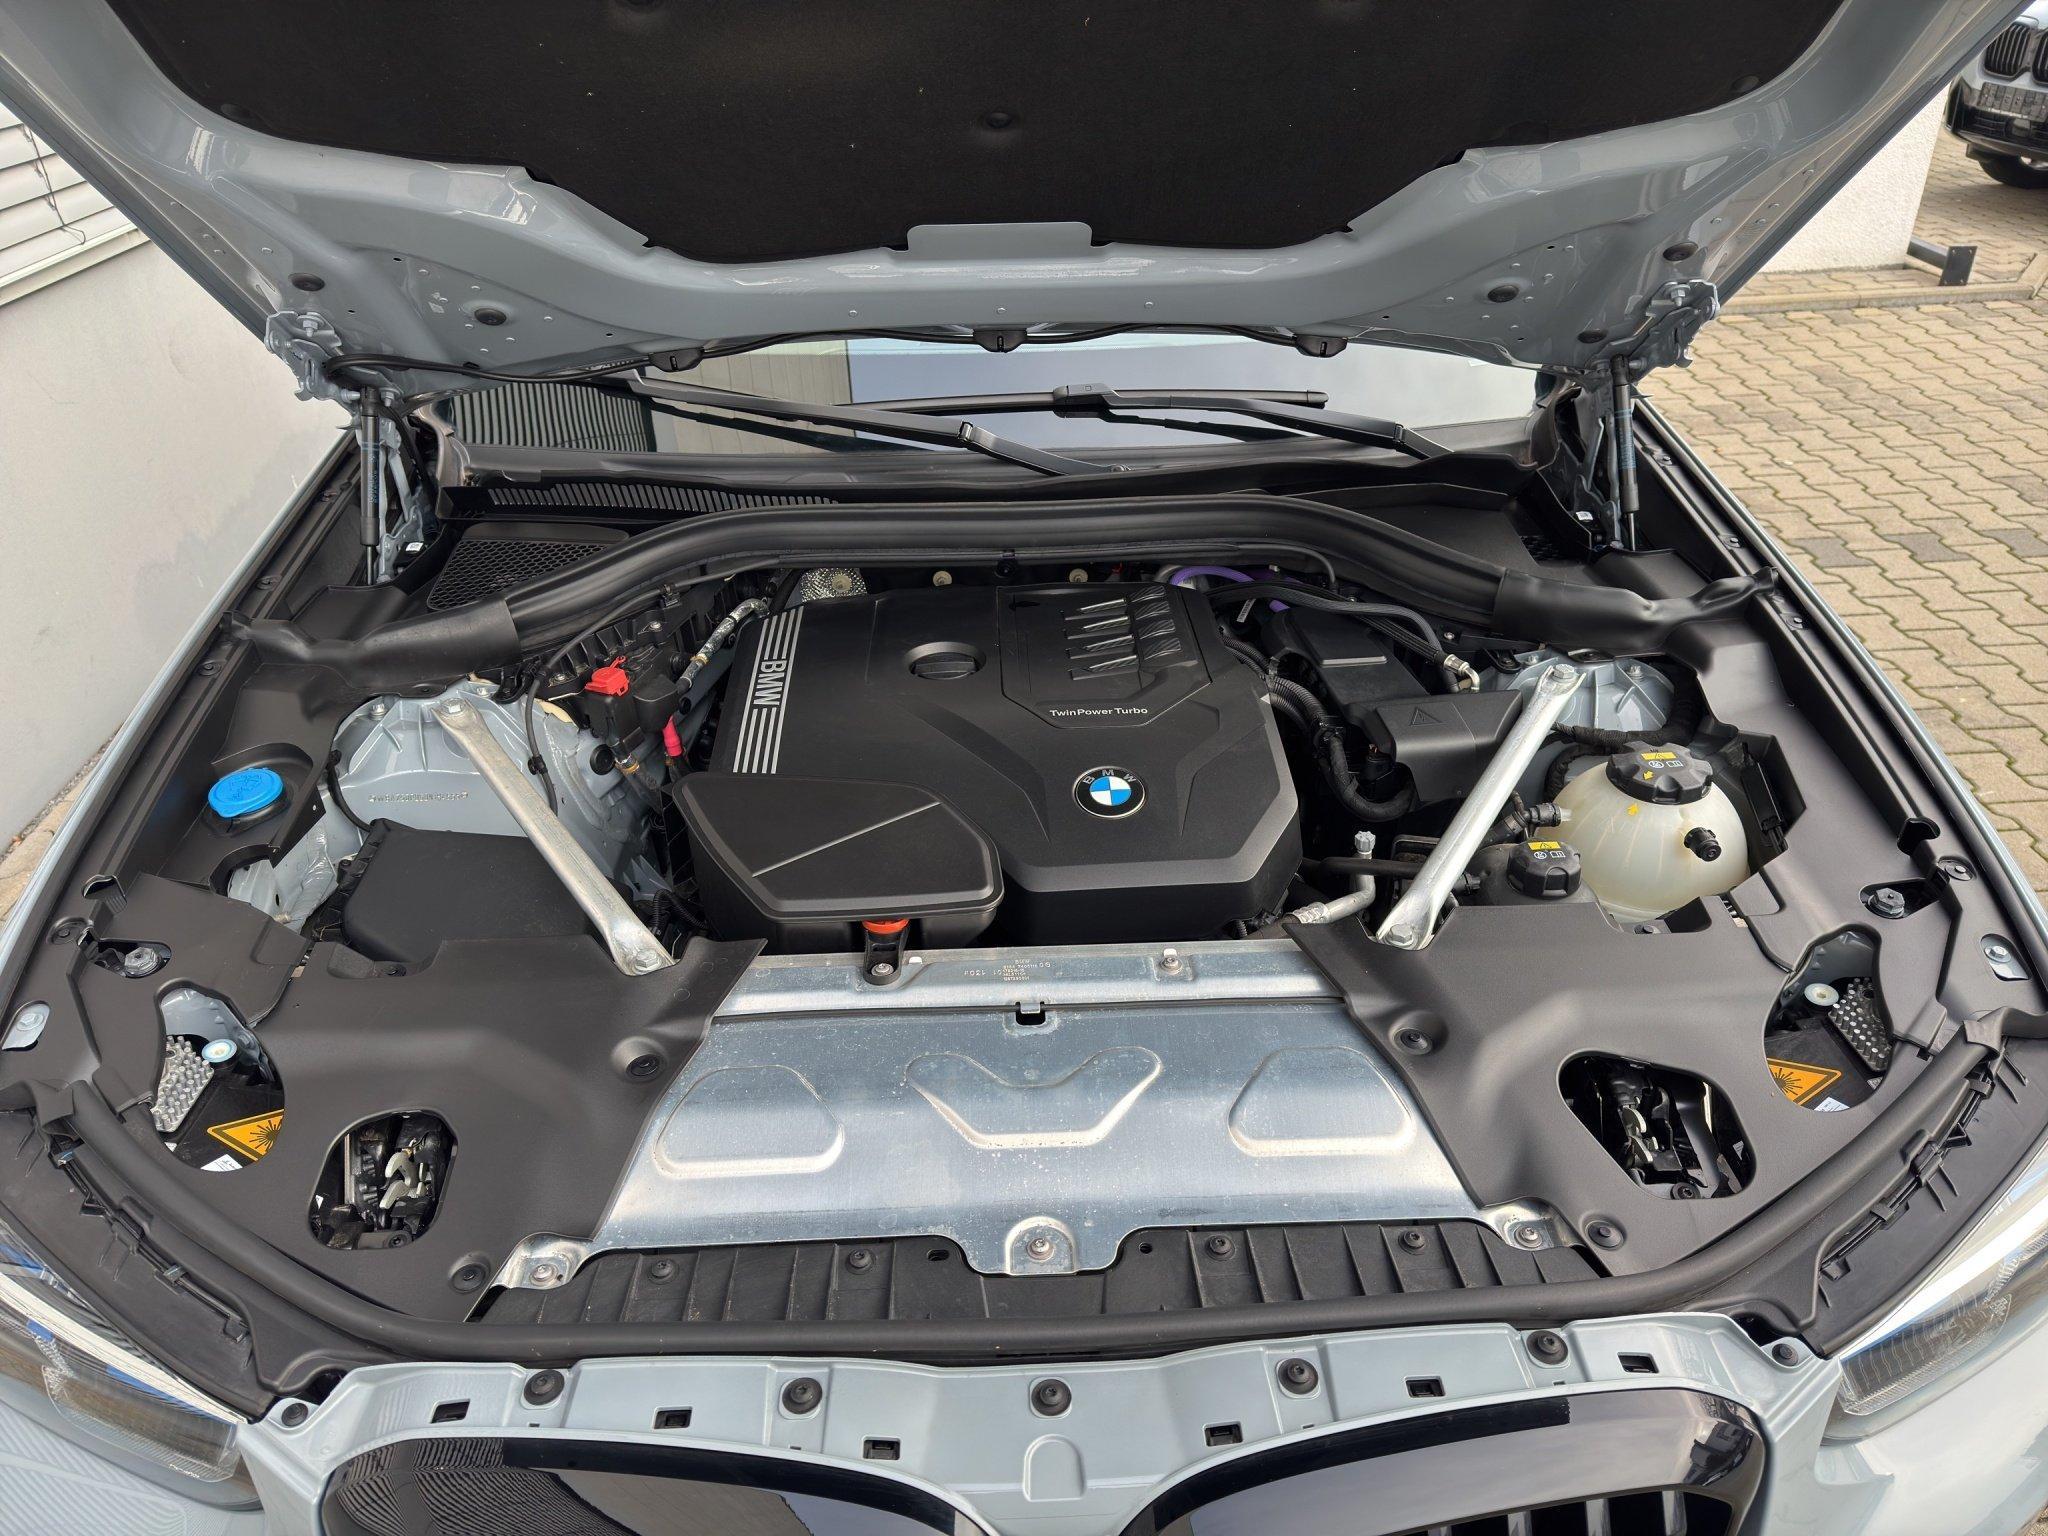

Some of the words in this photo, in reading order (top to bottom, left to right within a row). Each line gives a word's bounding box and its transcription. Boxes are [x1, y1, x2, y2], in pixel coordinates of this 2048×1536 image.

[753, 660, 787, 705] BMW
[1114, 707, 1148, 715] Turbo
[1082, 769, 1137, 785] BMW
